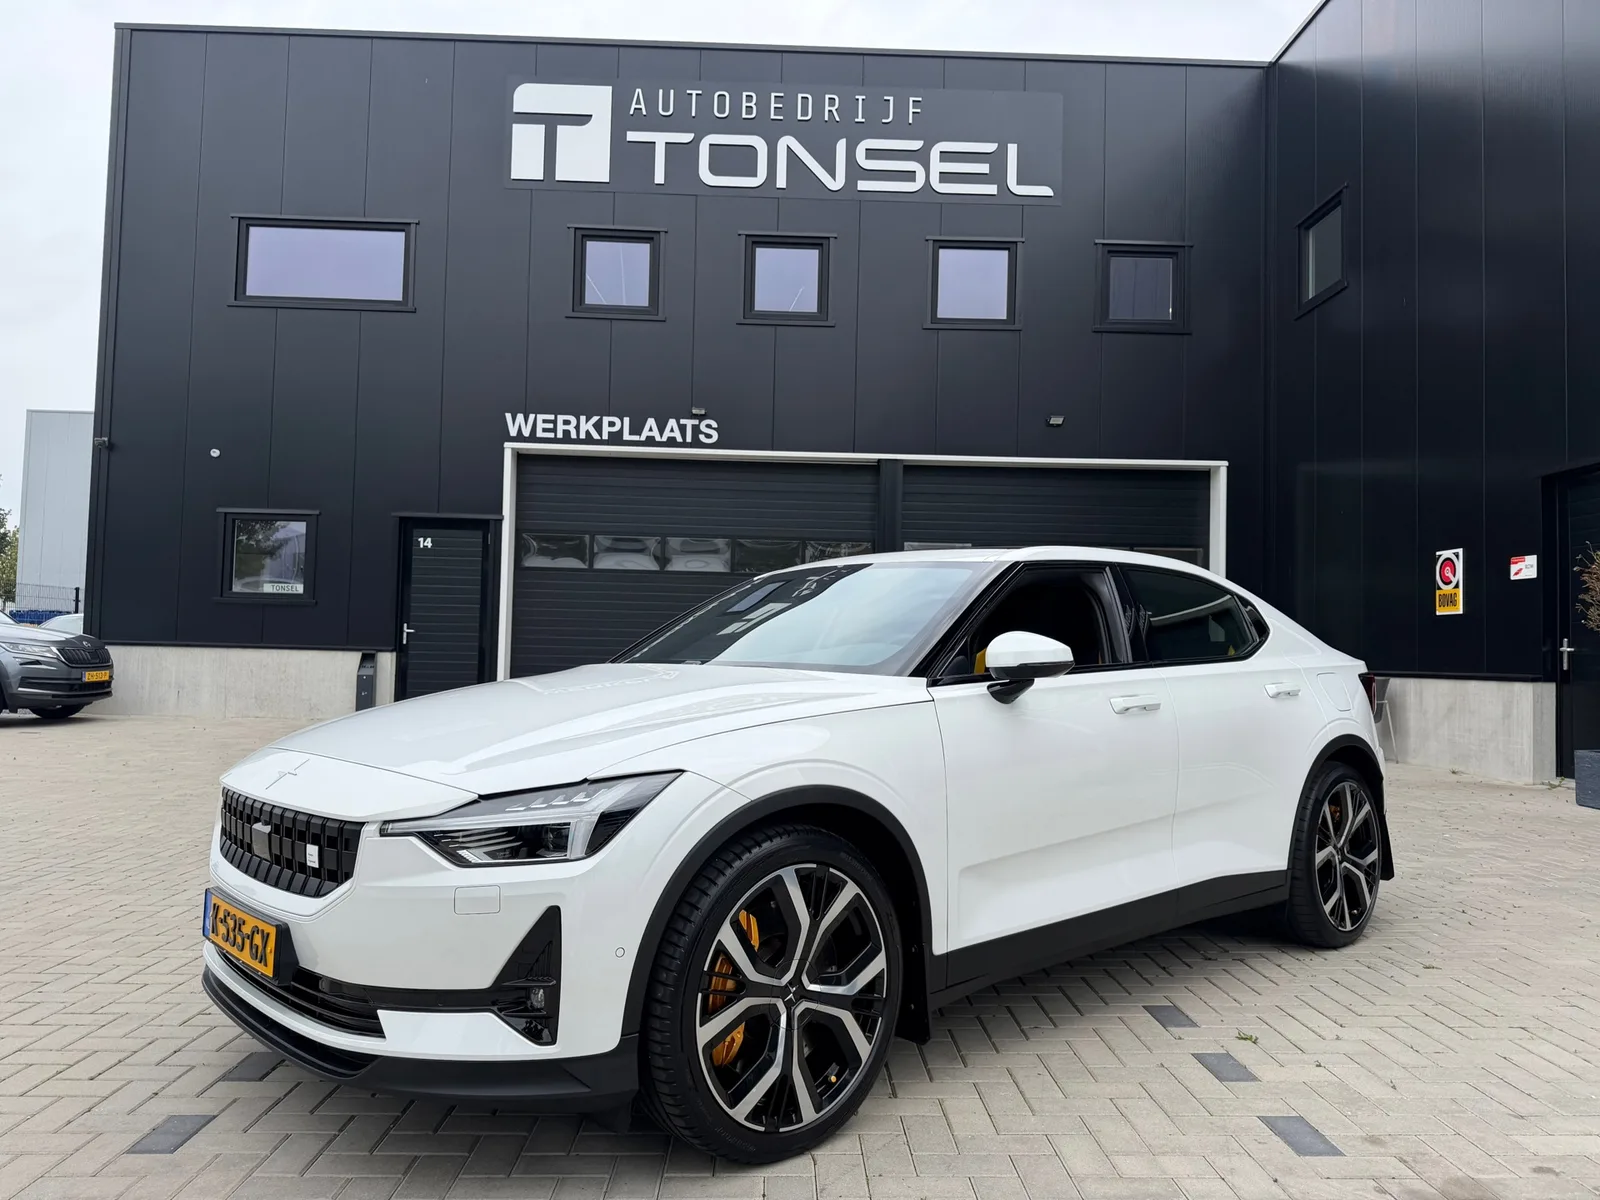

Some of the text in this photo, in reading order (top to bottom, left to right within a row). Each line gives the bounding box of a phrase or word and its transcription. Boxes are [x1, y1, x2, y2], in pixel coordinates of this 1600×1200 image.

[629, 87, 924, 124] AUTOBEDRIJF
[626, 131, 1054, 197] TONSEL
[505, 412, 719, 443] WERKPLAATS
[418, 537, 432, 548] 14
[271, 584, 299, 592] TONSEL
[1438, 592, 1457, 608] BOVAG
[211, 902, 270, 968] K-535-GX
